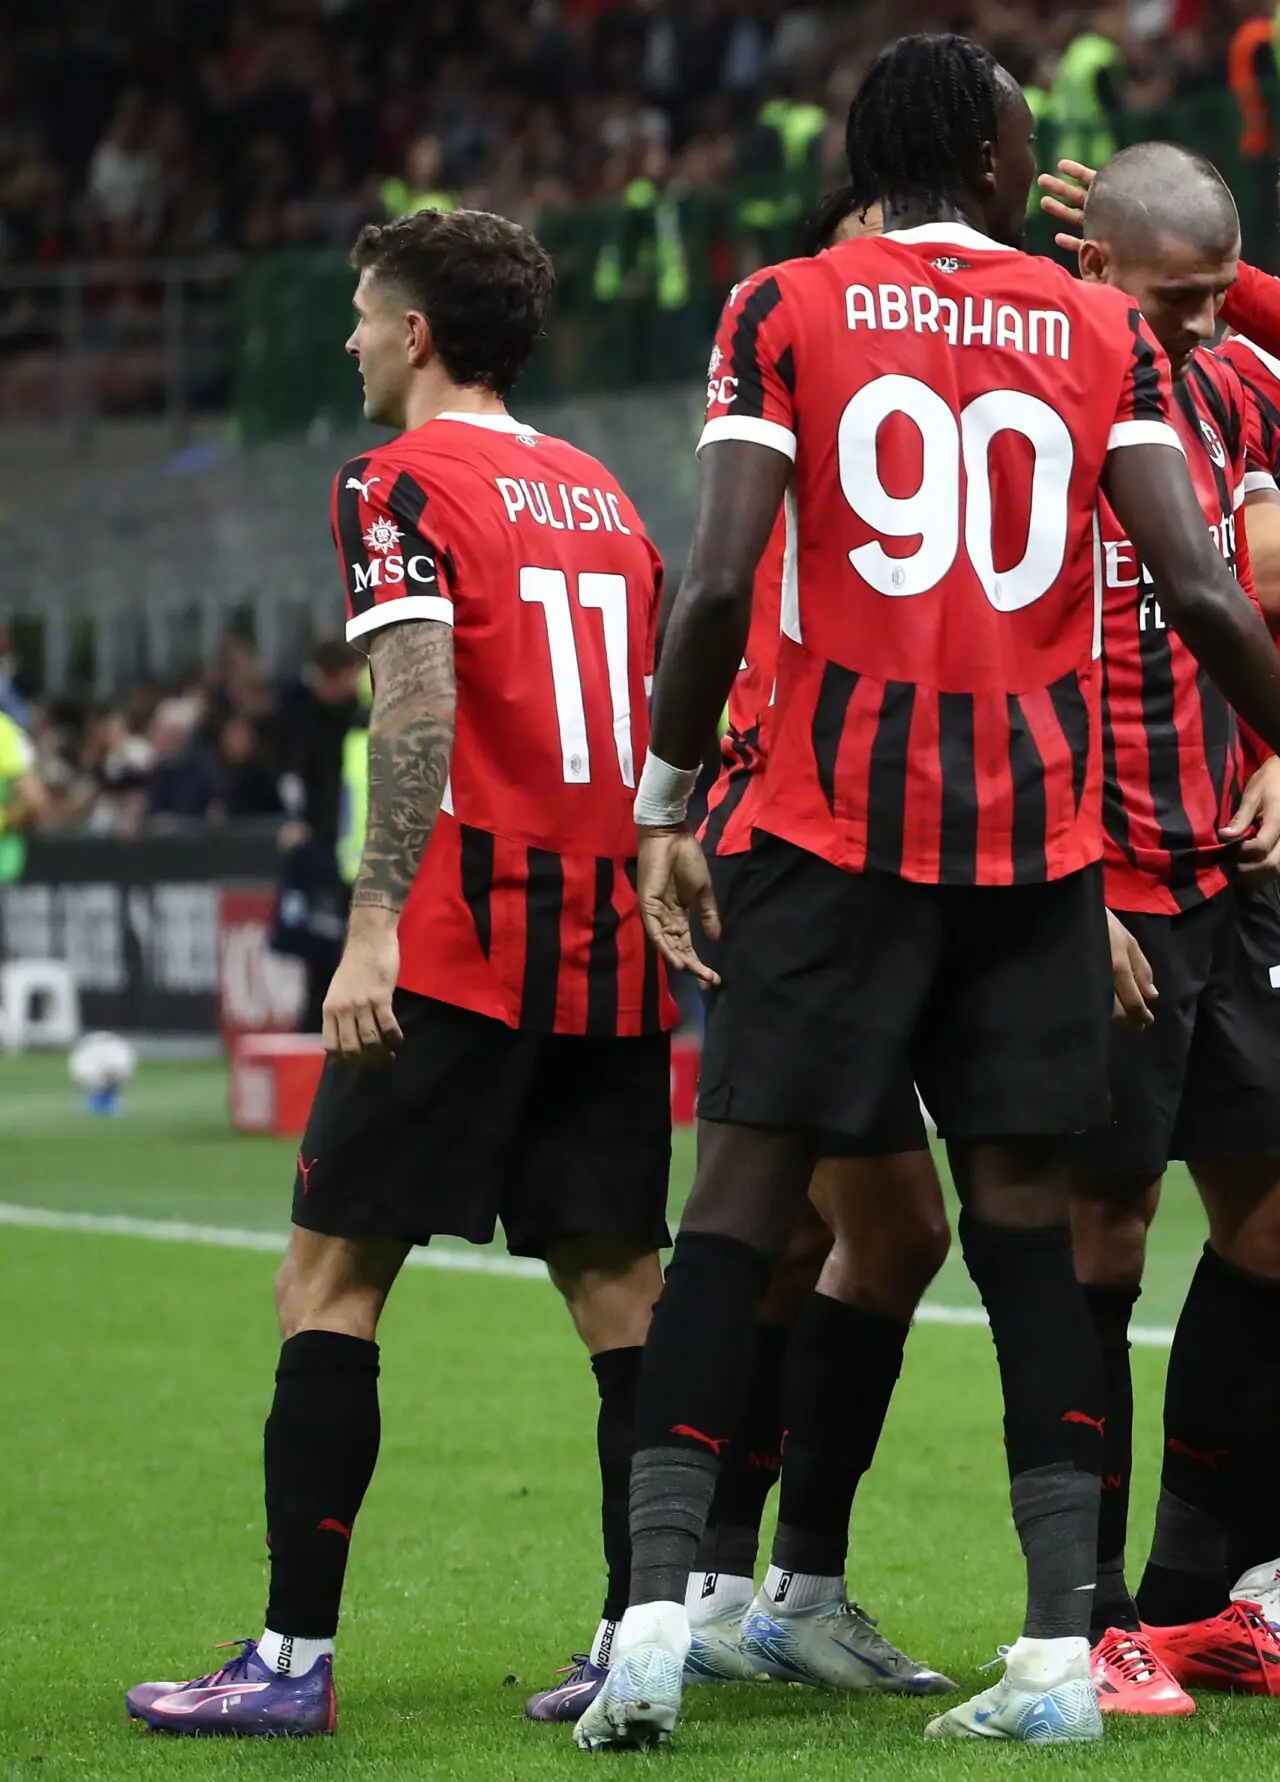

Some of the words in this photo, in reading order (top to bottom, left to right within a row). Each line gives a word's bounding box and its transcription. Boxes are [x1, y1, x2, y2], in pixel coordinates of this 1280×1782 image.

[844, 283, 1070, 360] ABRAHAM
[706, 376, 739, 409] SC
[494, 477, 632, 536] PULISIC
[837, 372, 1074, 613] 90
[352, 554, 436, 594] MSC
[1139, 592, 1167, 632] FL
[519, 565, 636, 790] 11
[276, 1634, 294, 1676] ESIGN
[596, 1619, 617, 1668] EDESIGN
